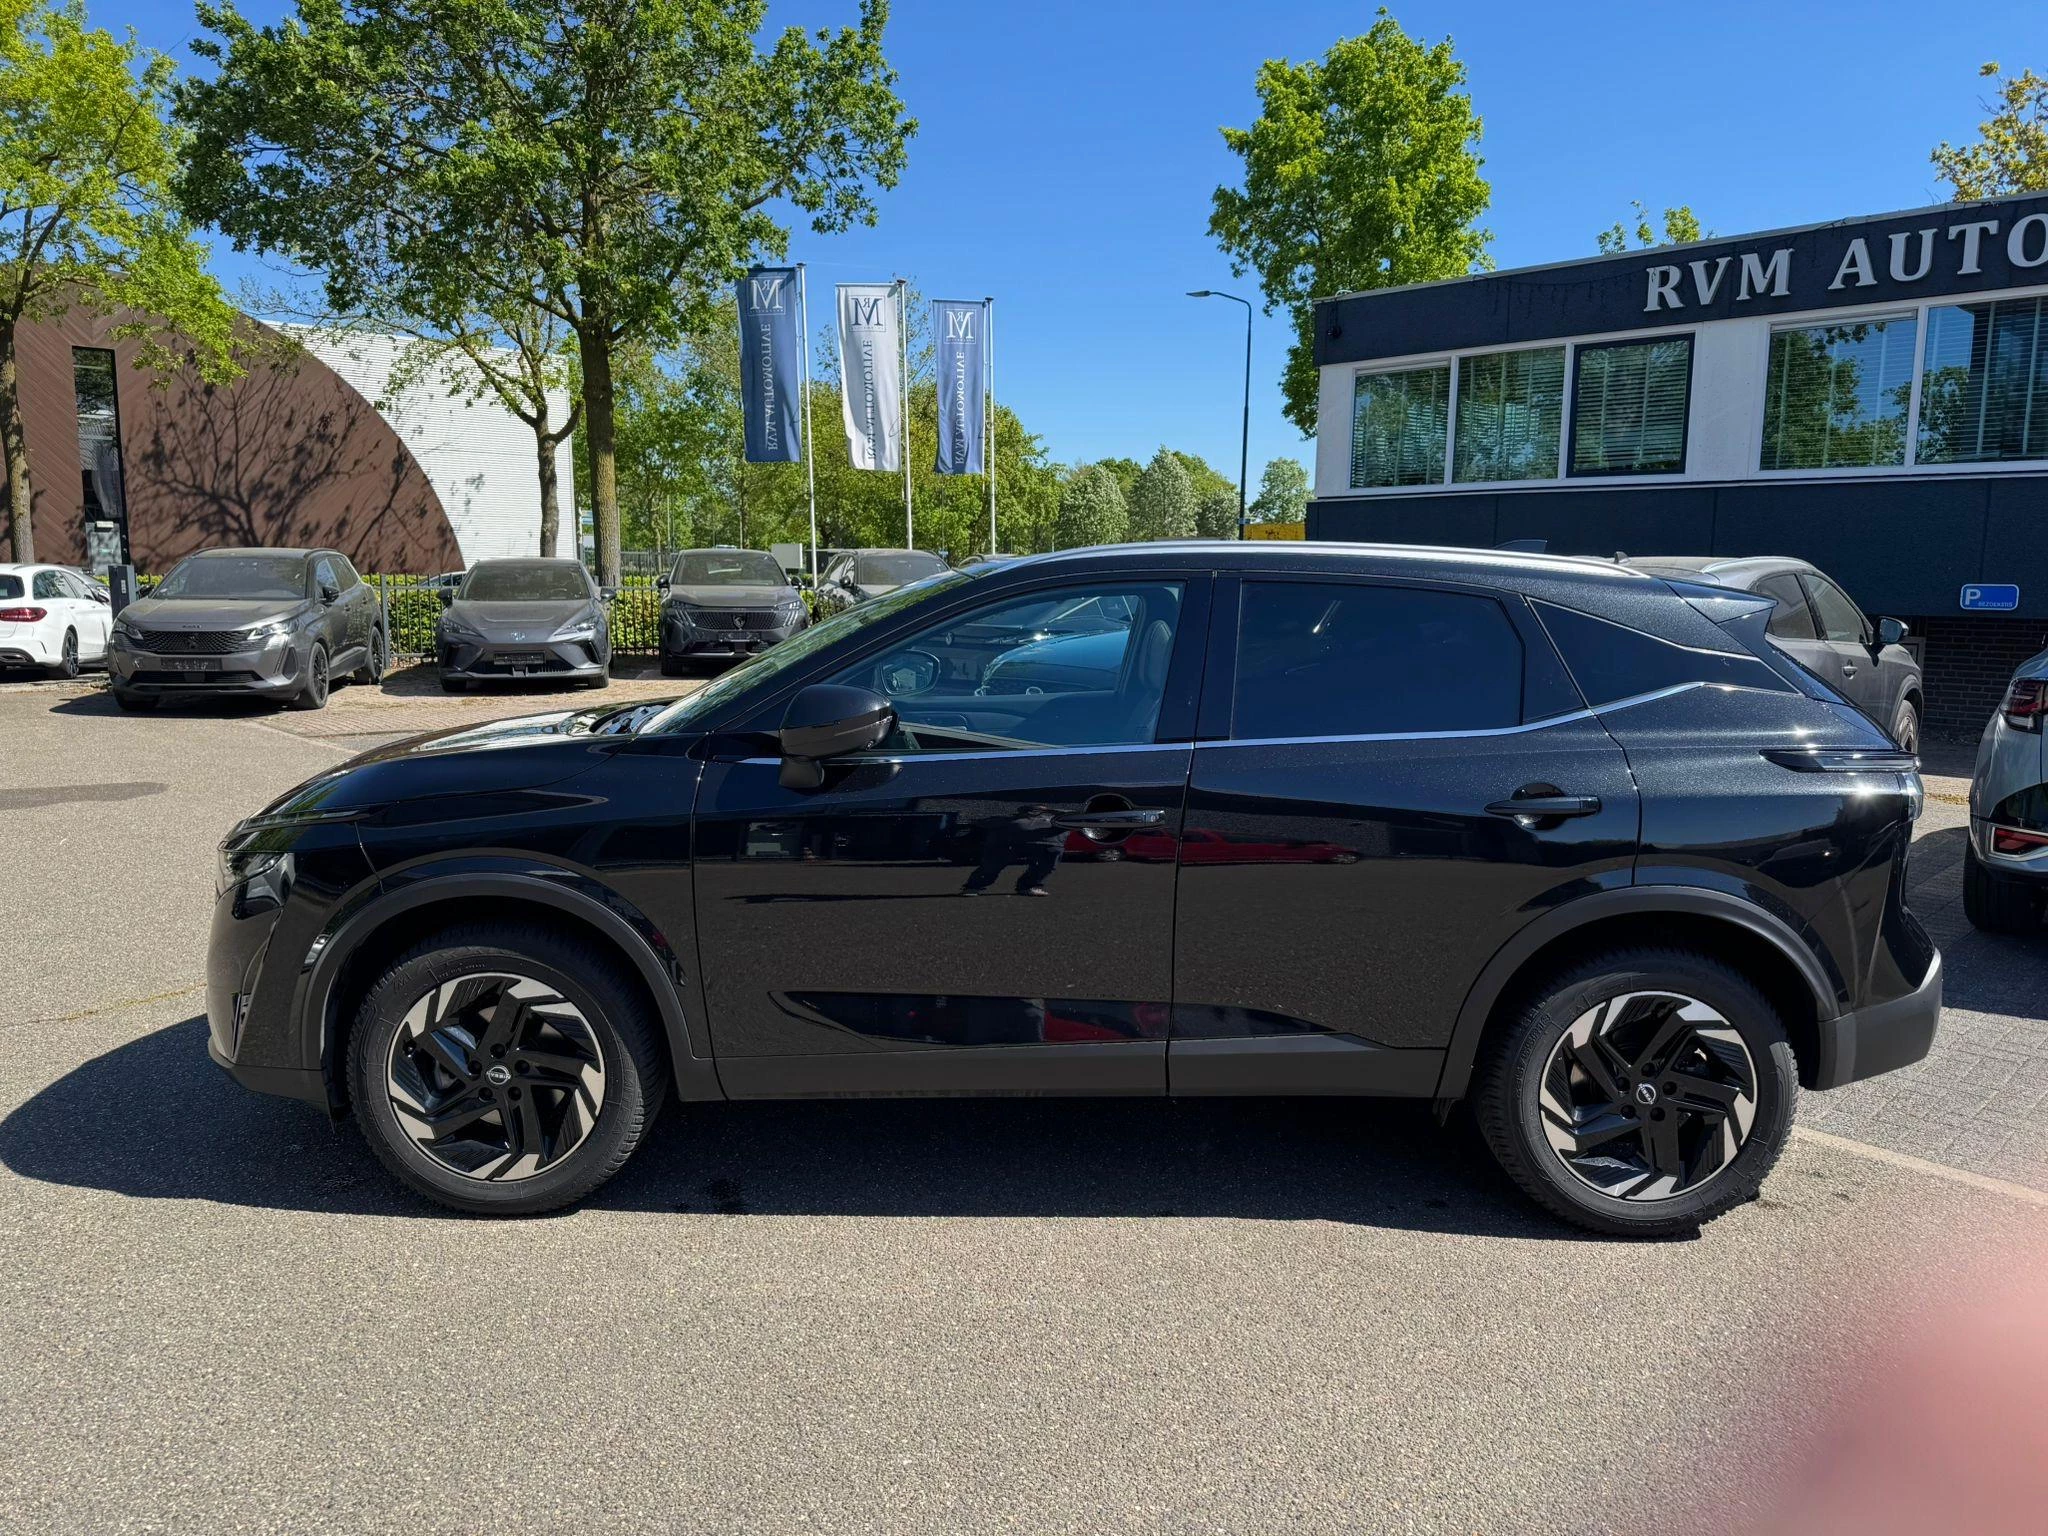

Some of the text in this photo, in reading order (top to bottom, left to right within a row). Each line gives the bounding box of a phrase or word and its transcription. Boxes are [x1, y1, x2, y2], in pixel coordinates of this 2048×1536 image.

[1643, 213, 2048, 313] RVM AUTO
[1964, 589, 1981, 605] P
